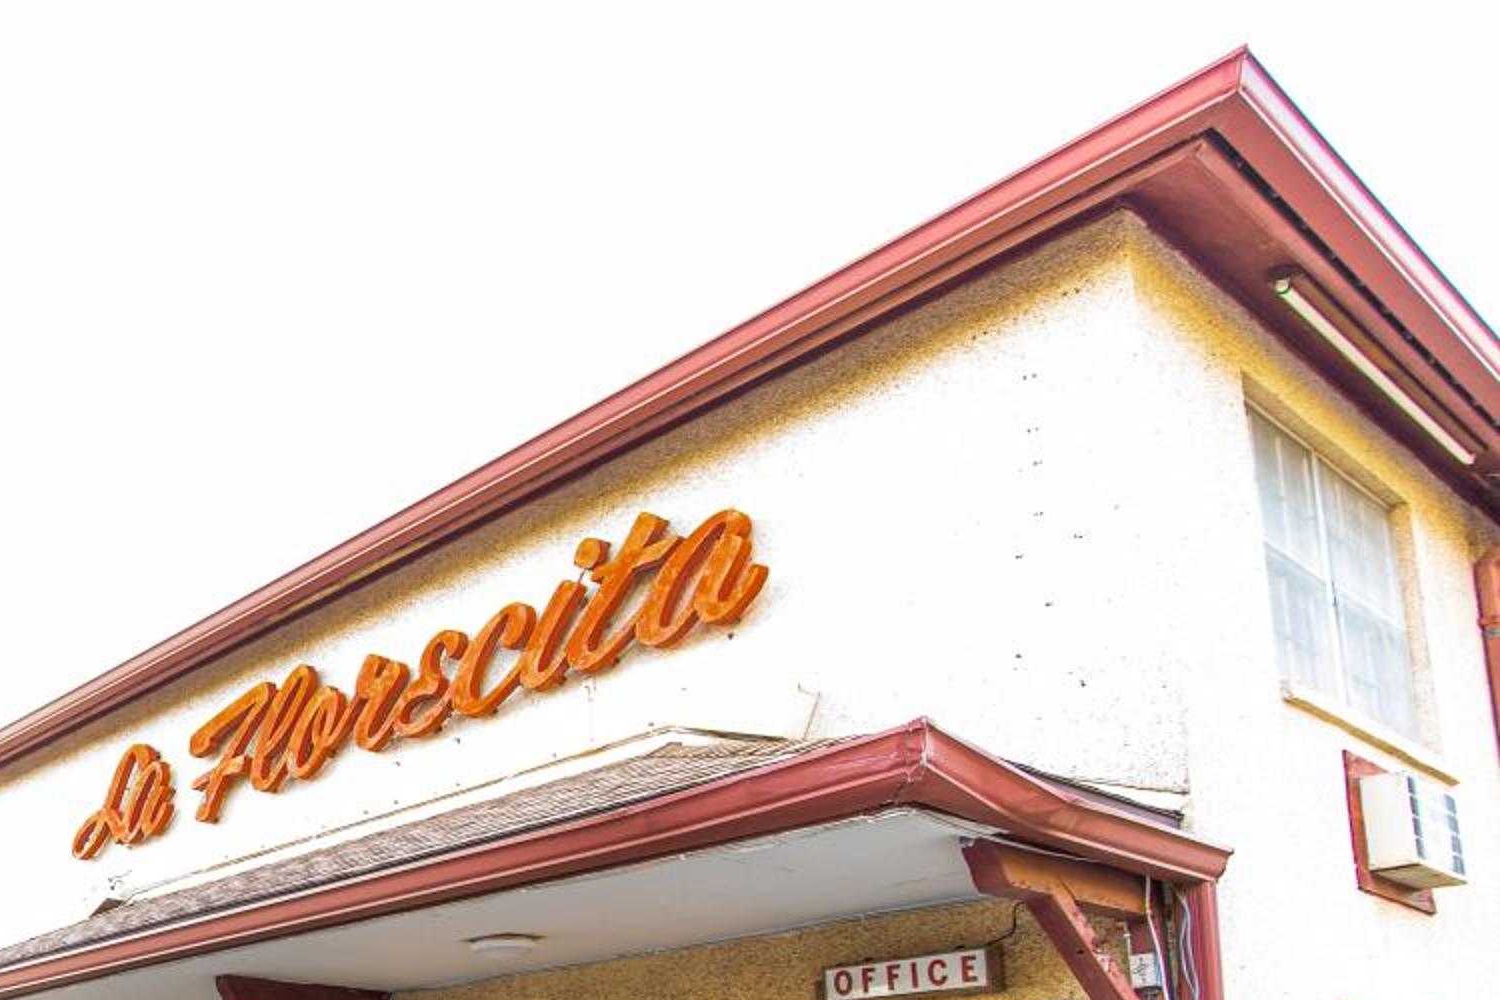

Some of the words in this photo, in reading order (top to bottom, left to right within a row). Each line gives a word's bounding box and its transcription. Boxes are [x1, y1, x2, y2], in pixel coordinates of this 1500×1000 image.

[73, 744, 175, 859] La
[190, 509, 769, 824] Florecita
[834, 954, 979, 996] OFFICE
